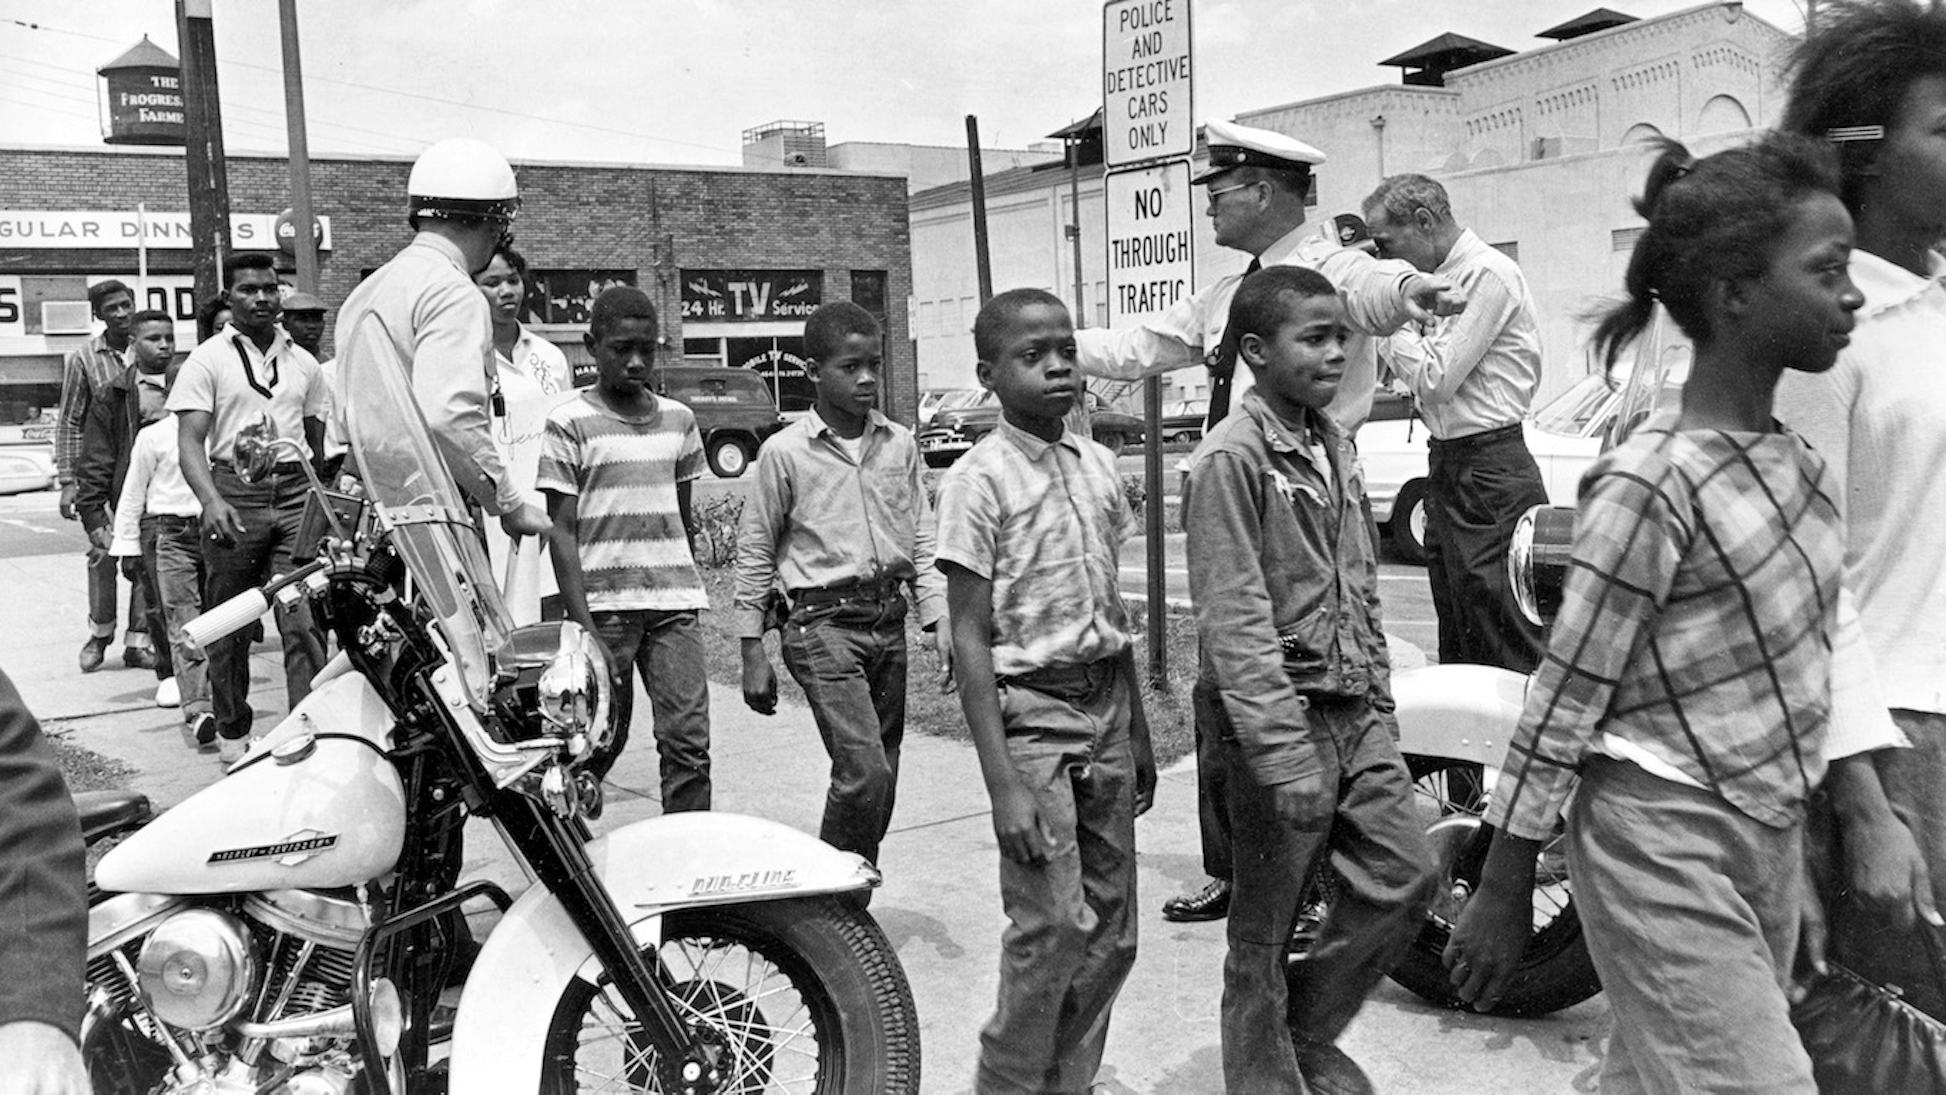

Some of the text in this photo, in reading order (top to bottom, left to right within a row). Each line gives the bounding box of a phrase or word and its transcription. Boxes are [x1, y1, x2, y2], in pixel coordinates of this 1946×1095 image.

[1119, 1, 1173, 33] POLICE
[1131, 31, 1163, 60] AND
[150, 76, 179, 89] THE
[1107, 55, 1190, 95] DETECTIVE
[121, 92, 184, 107] PROGRES
[1127, 91, 1169, 120] CARS
[139, 107, 185, 124] FARME
[1128, 121, 1169, 150] ONLY
[1134, 187, 1163, 221] NO
[0, 221, 255, 239] GULAR DINNS
[1111, 231, 1189, 270] THROUGH
[681, 301, 704, 317] 24
[708, 300, 726, 316] Hr.
[727, 282, 771, 316] TV
